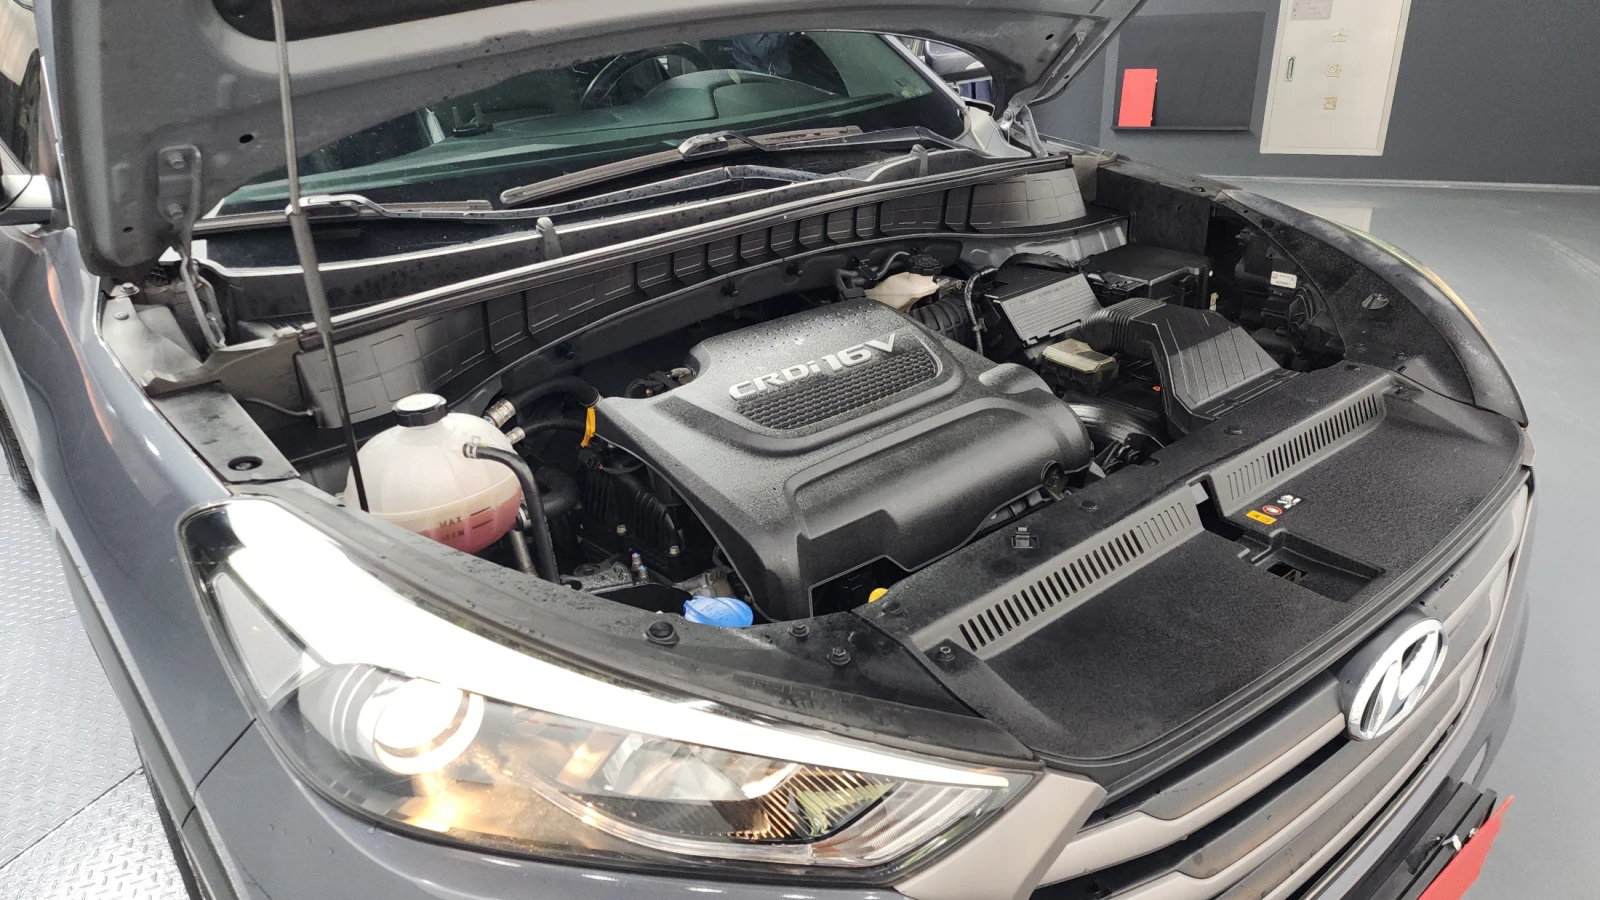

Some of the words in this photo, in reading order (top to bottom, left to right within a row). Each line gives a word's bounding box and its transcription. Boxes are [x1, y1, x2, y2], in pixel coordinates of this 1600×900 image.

[729, 360, 822, 399] CRDi
[821, 333, 896, 372] 16V
[439, 516, 462, 528] MAX
